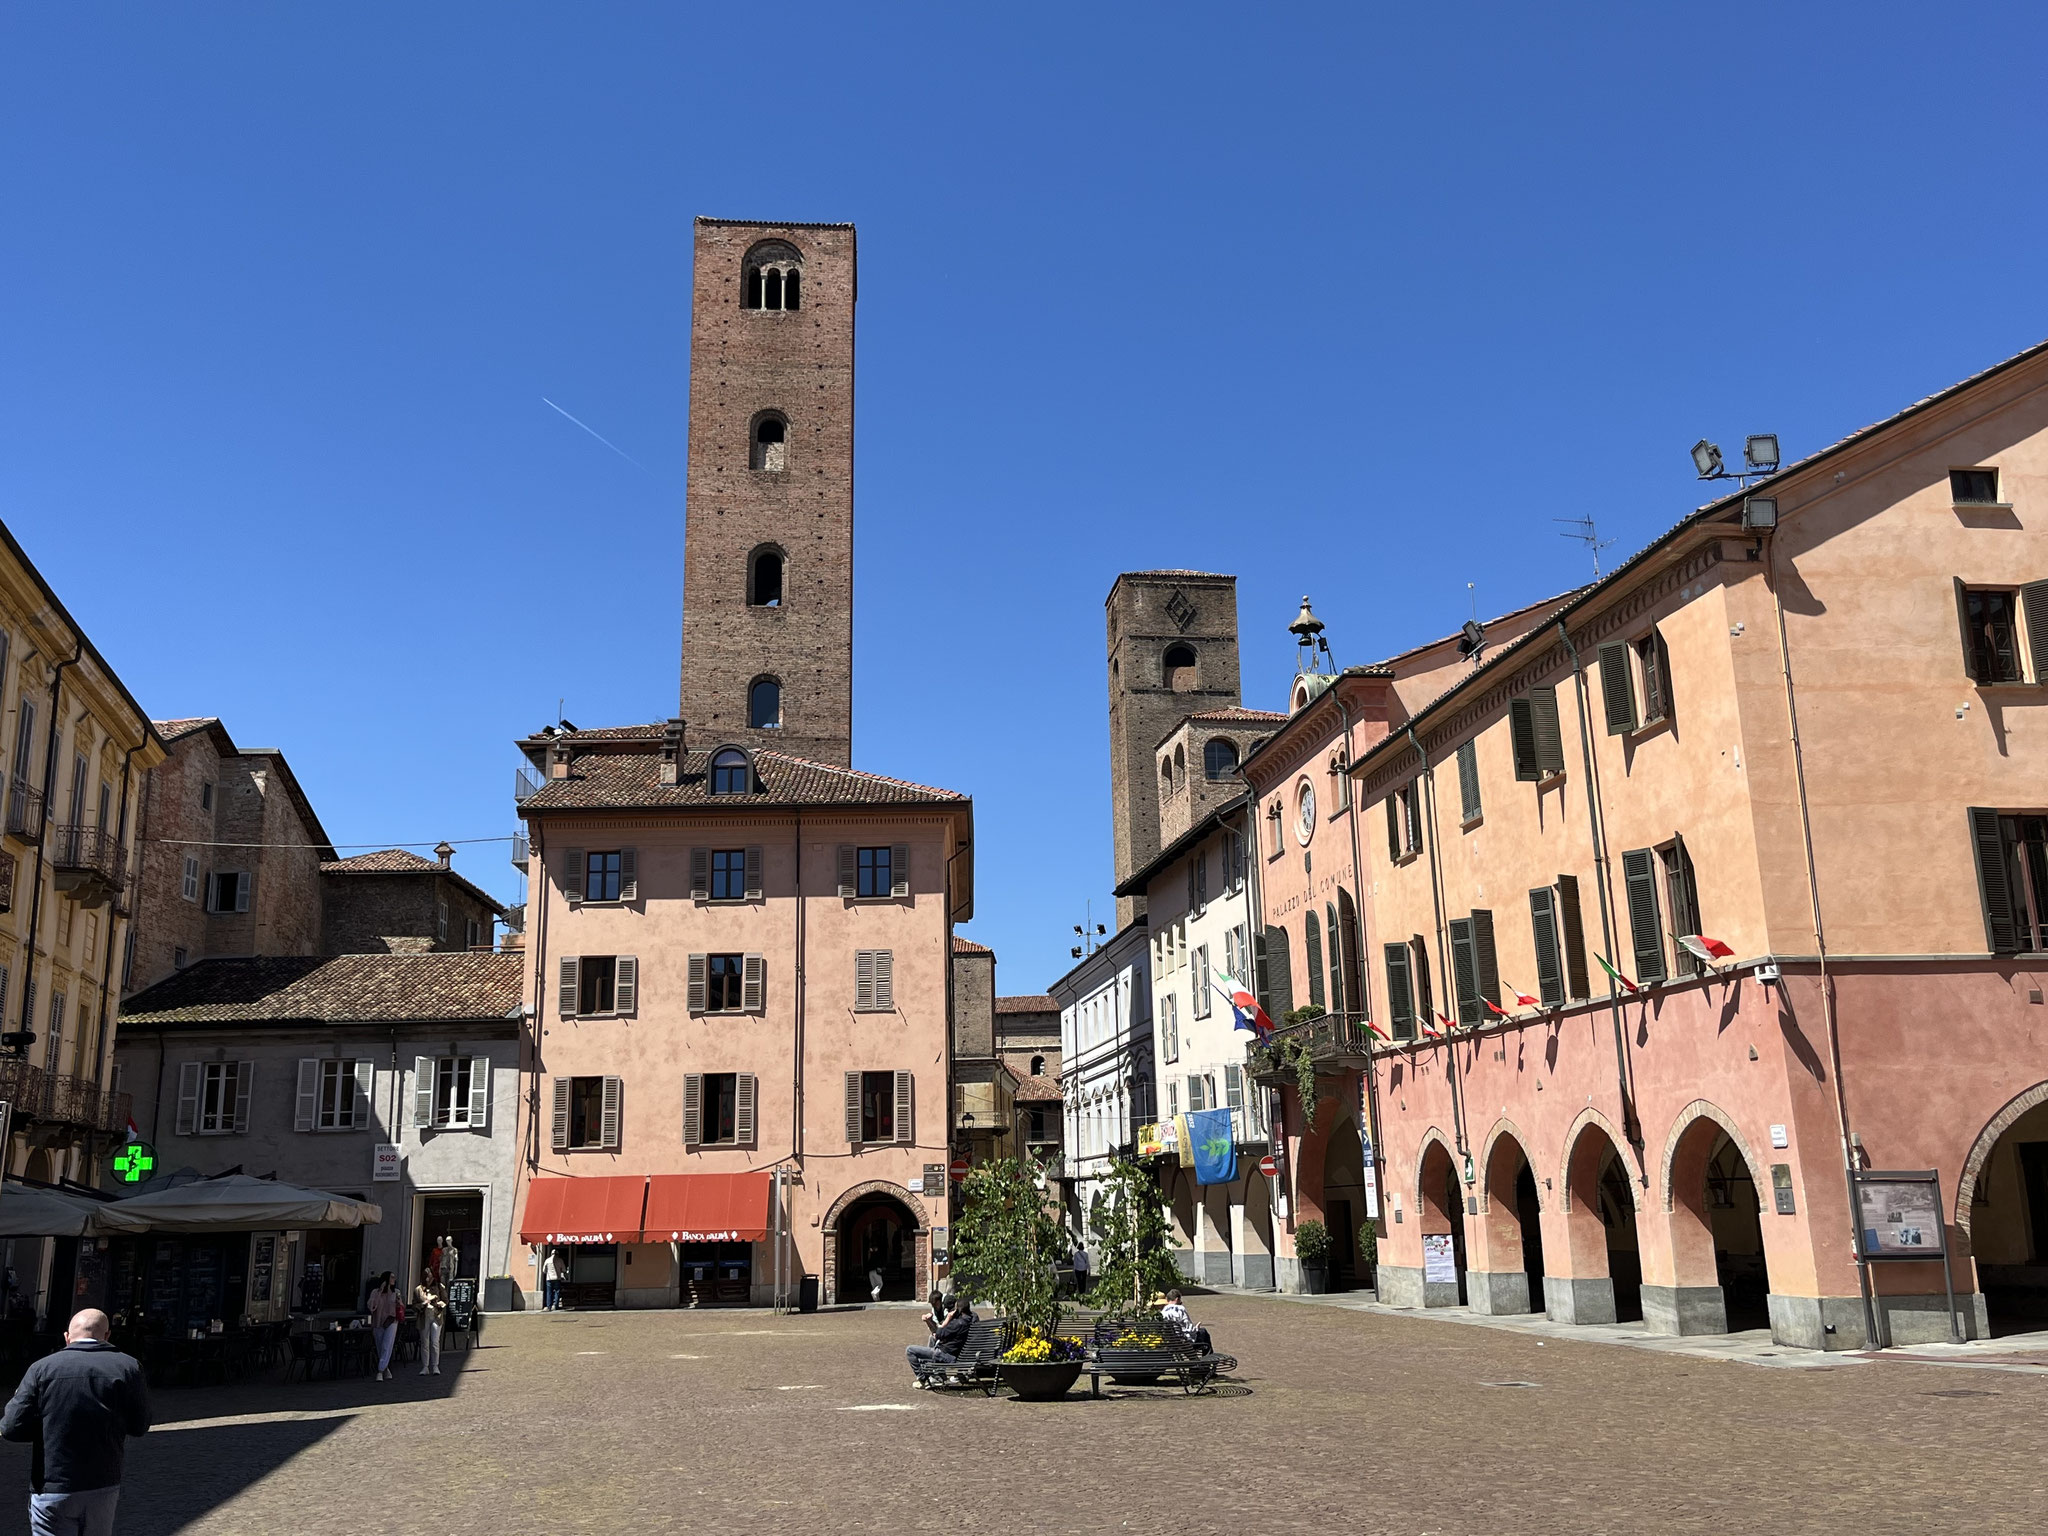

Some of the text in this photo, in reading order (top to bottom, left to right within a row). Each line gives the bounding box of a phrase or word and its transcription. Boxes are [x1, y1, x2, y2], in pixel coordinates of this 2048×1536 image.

[1272, 864, 1353, 919] PALAZZO DEL COMUNE
[1359, 1081, 1369, 1145] VINUM
[379, 1154, 397, 1162] S02
[556, 1233, 579, 1242] BANCA
[682, 1231, 705, 1240] BANCA
